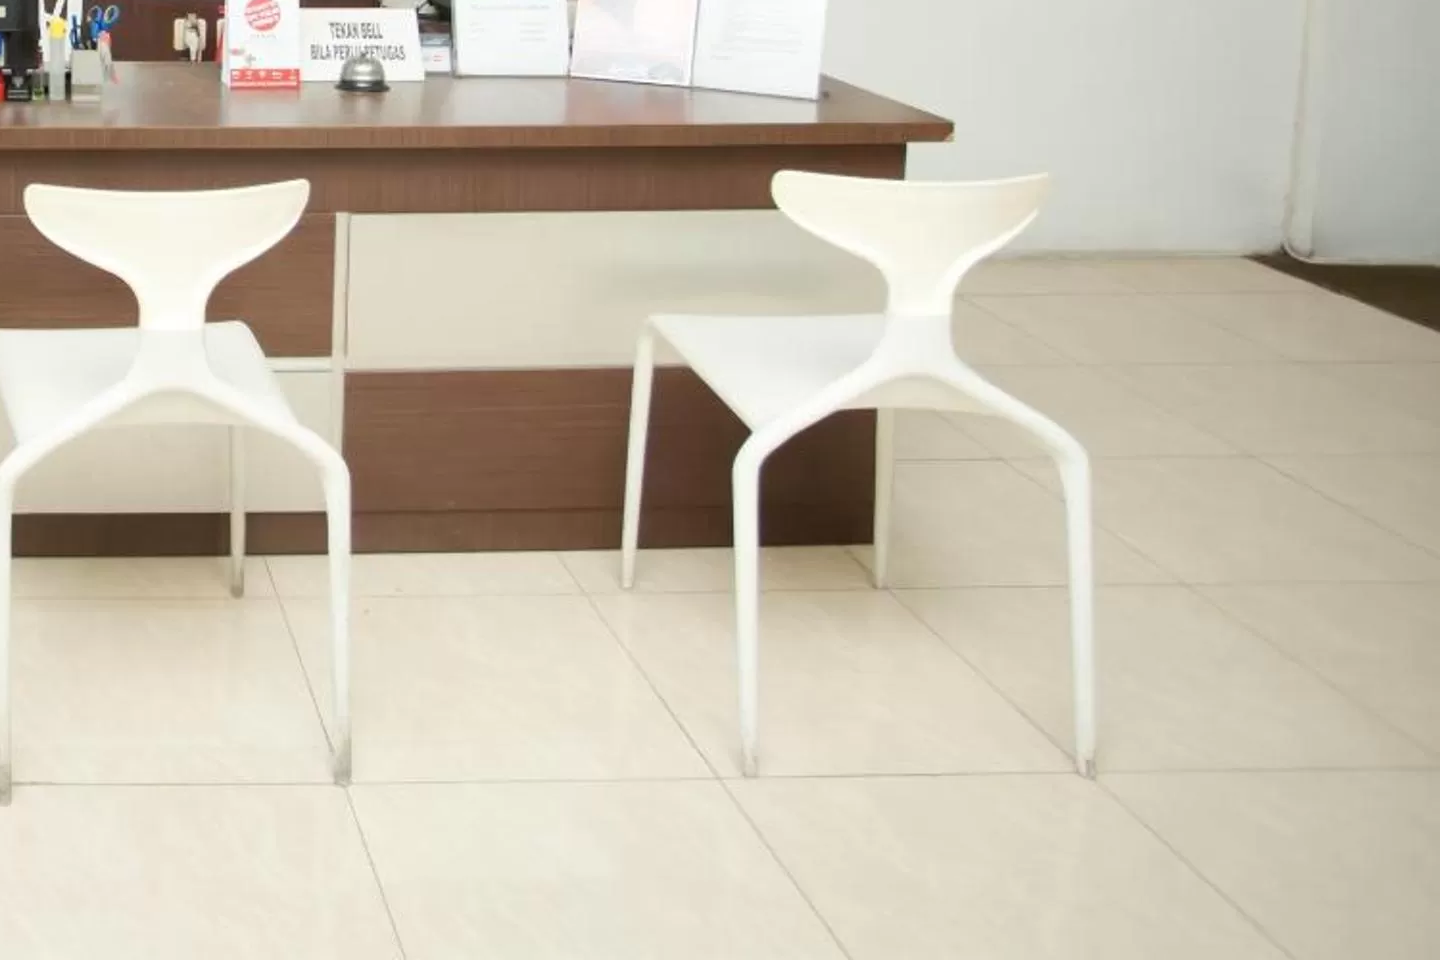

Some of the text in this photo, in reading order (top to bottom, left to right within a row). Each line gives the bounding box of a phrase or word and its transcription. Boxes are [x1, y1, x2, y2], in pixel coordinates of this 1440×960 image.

[328, 22, 383, 40] TEKAN BELL
[310, 44, 332, 61] BILA
